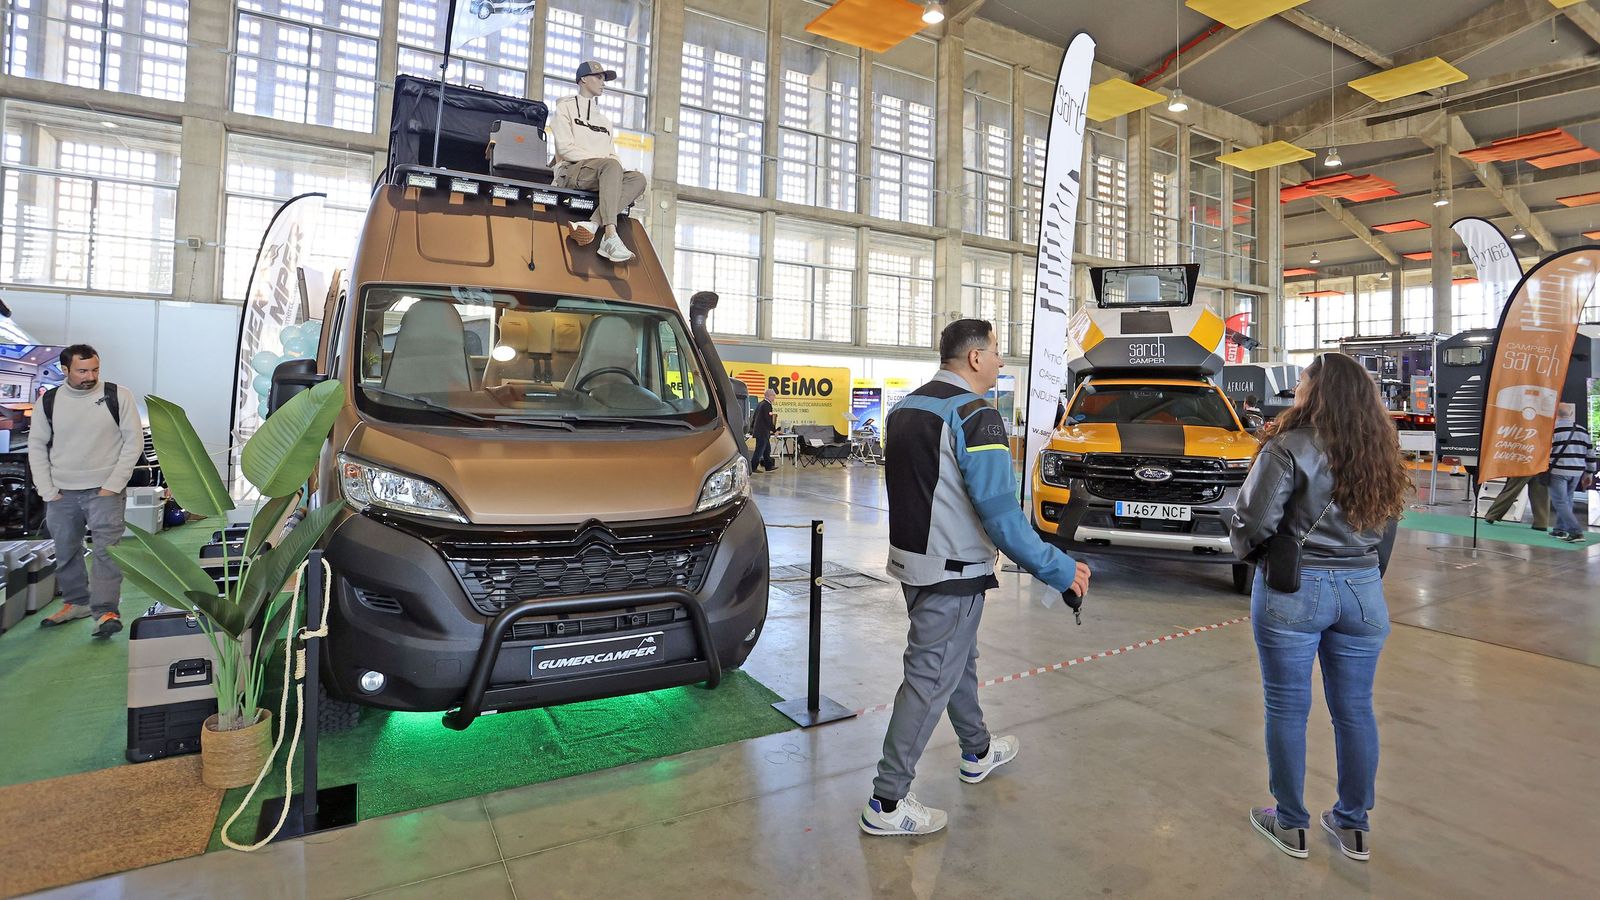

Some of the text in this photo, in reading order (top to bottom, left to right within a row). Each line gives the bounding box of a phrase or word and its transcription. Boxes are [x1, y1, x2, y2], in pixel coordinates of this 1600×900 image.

[1129, 336, 1166, 358] sarch
[1506, 342, 1552, 354] CAMPER
[1502, 344, 1560, 377] sarch
[1227, 381, 1254, 392] AFRICAN
[1497, 424, 1538, 441] WILD
[1495, 440, 1536, 453] CAMPING
[1493, 451, 1534, 465] LOVERS
[1143, 467, 1162, 478] Ford
[1127, 503, 1187, 518] 1467 NCF
[538, 645, 657, 670] GUMERCAMPER
